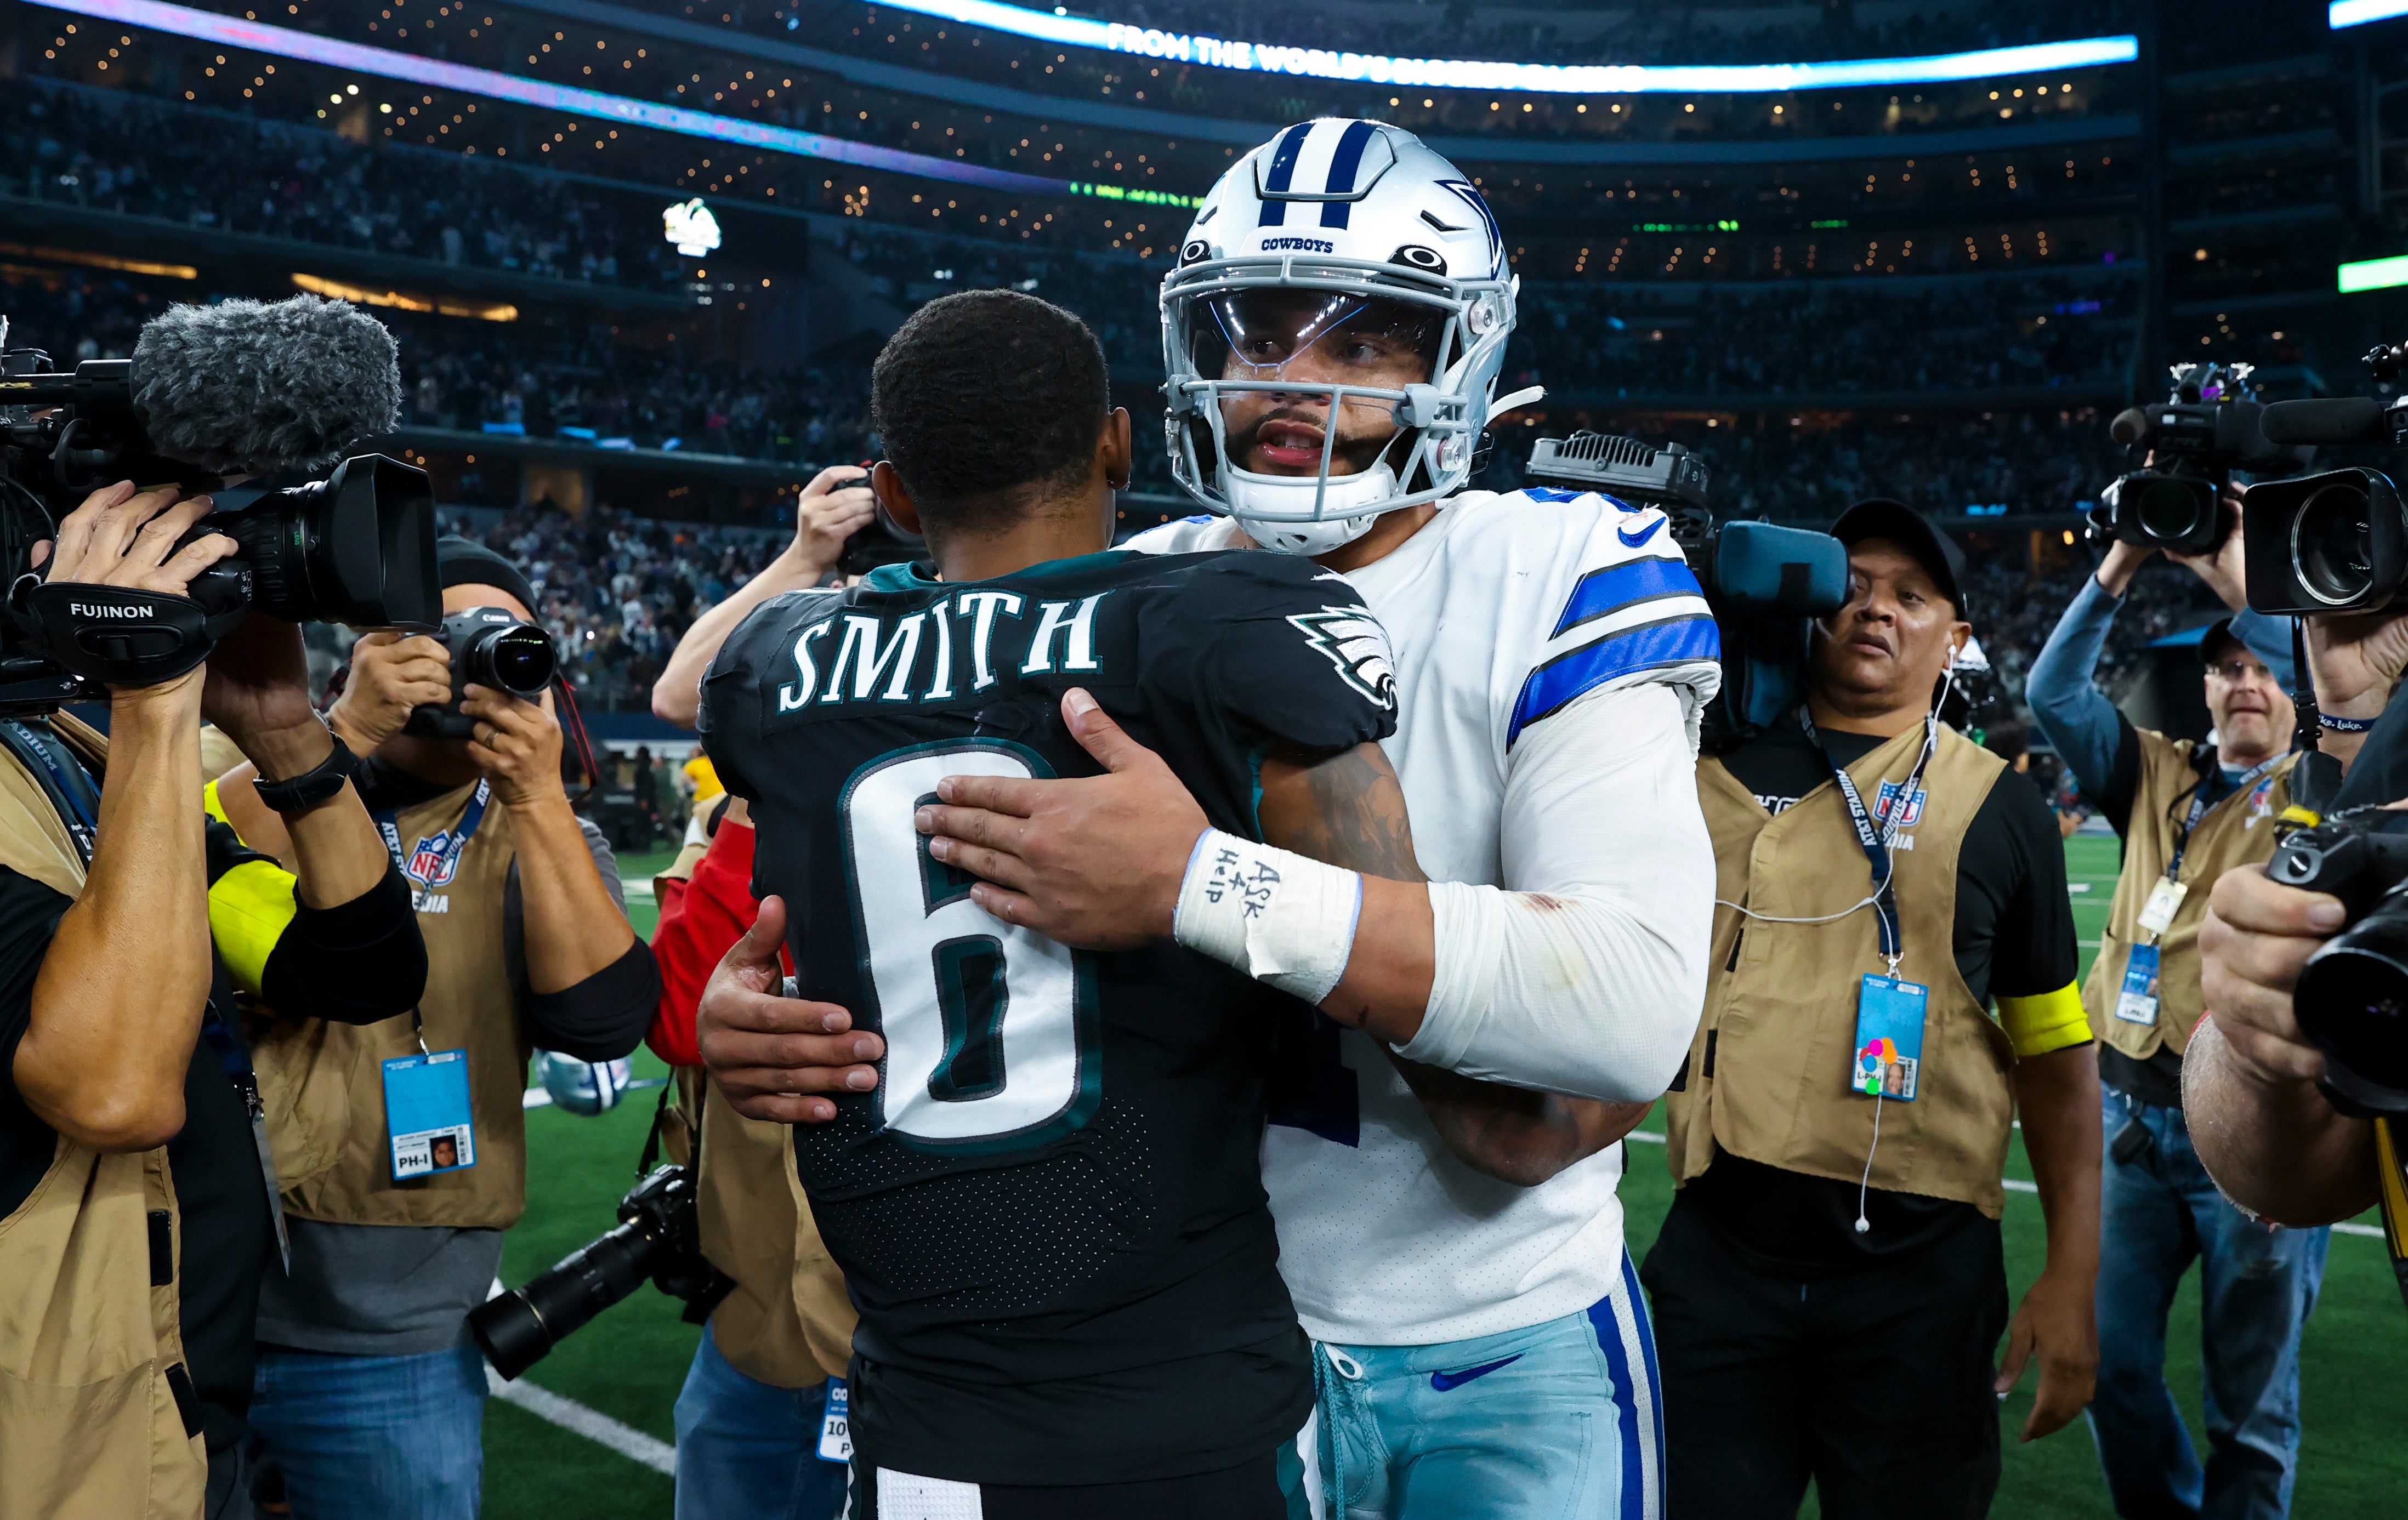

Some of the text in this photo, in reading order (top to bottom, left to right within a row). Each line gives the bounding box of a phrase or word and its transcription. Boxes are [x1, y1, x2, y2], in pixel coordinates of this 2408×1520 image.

[1108, 22, 1190, 61] FROM
[1194, 36, 1252, 70] THE
[1255, 44, 1389, 83] WORLD'S
[1262, 238, 1333, 253] COWBOYS
[71, 604, 153, 618] FUJINON
[777, 589, 1115, 715] SMITH
[2319, 715, 2362, 730] ke. Luke.
[11, 722, 58, 771] ADIUM
[1836, 768, 1878, 846] AT&T STADIUM
[1878, 798, 1913, 820] NL
[381, 822, 402, 853] AT&T
[1884, 833, 1915, 851] DIA
[412, 890, 449, 914] EDIA
[837, 737, 1101, 1157] 6
